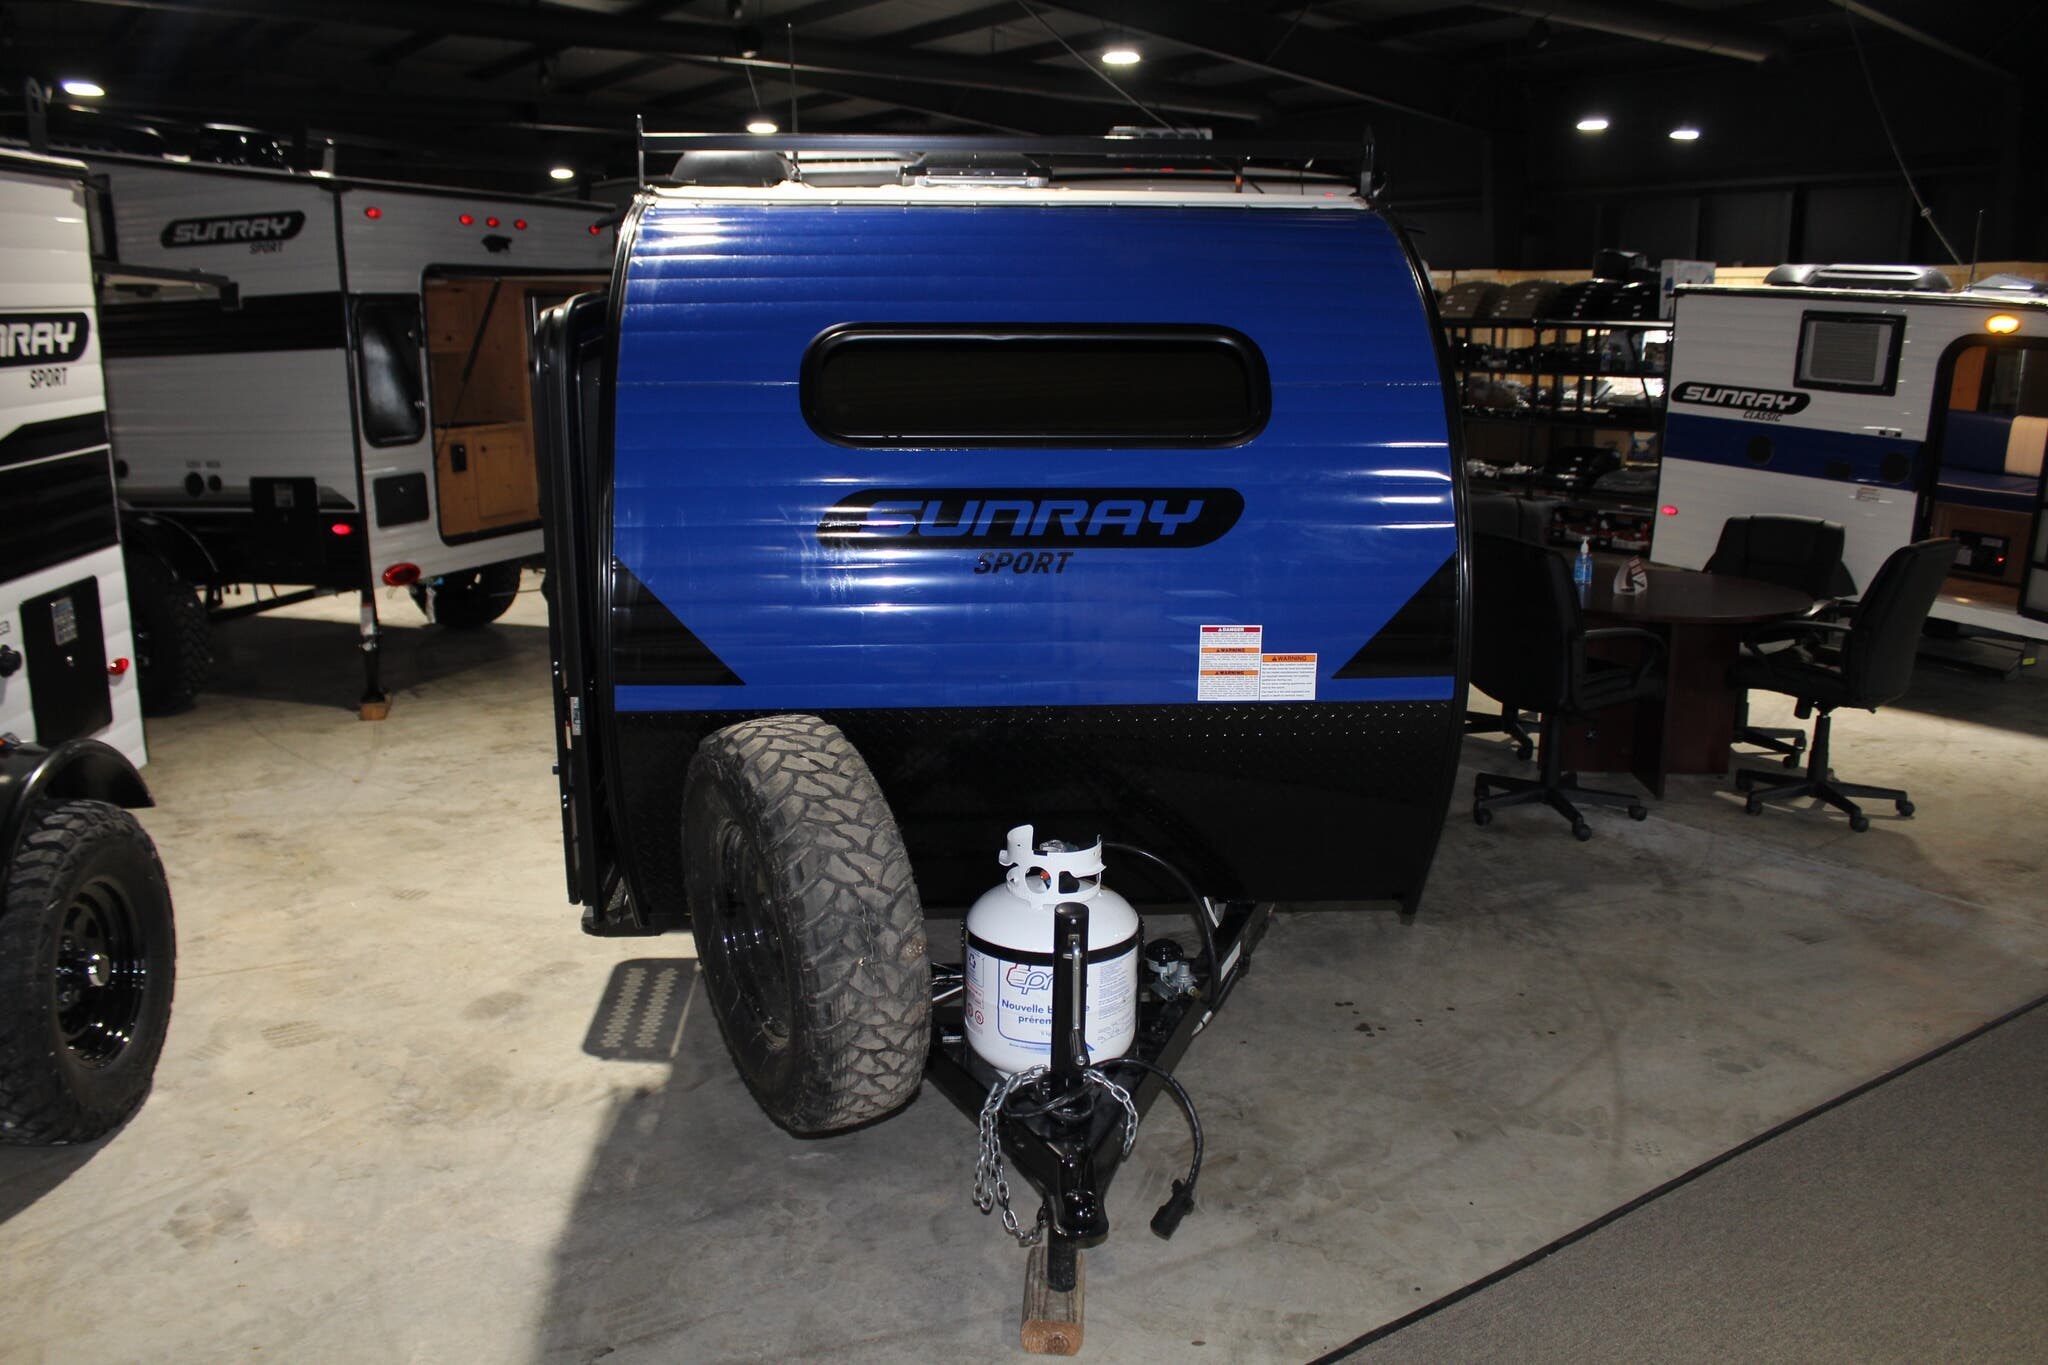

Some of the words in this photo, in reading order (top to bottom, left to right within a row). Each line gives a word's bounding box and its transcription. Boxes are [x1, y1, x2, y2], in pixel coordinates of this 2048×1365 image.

[174, 217, 292, 242] SUNRAY
[249, 241, 284, 254] SPORT
[30, 367, 67, 388] SPORT
[1683, 386, 1797, 410] SUNRAY
[1743, 409, 1782, 422] CLASSIC
[863, 500, 1204, 537] SUNRAY
[974, 551, 1074, 575] SPORT
[1001, 999, 1044, 1014] Nouvelle
[1018, 1015, 1052, 1025] prérem
